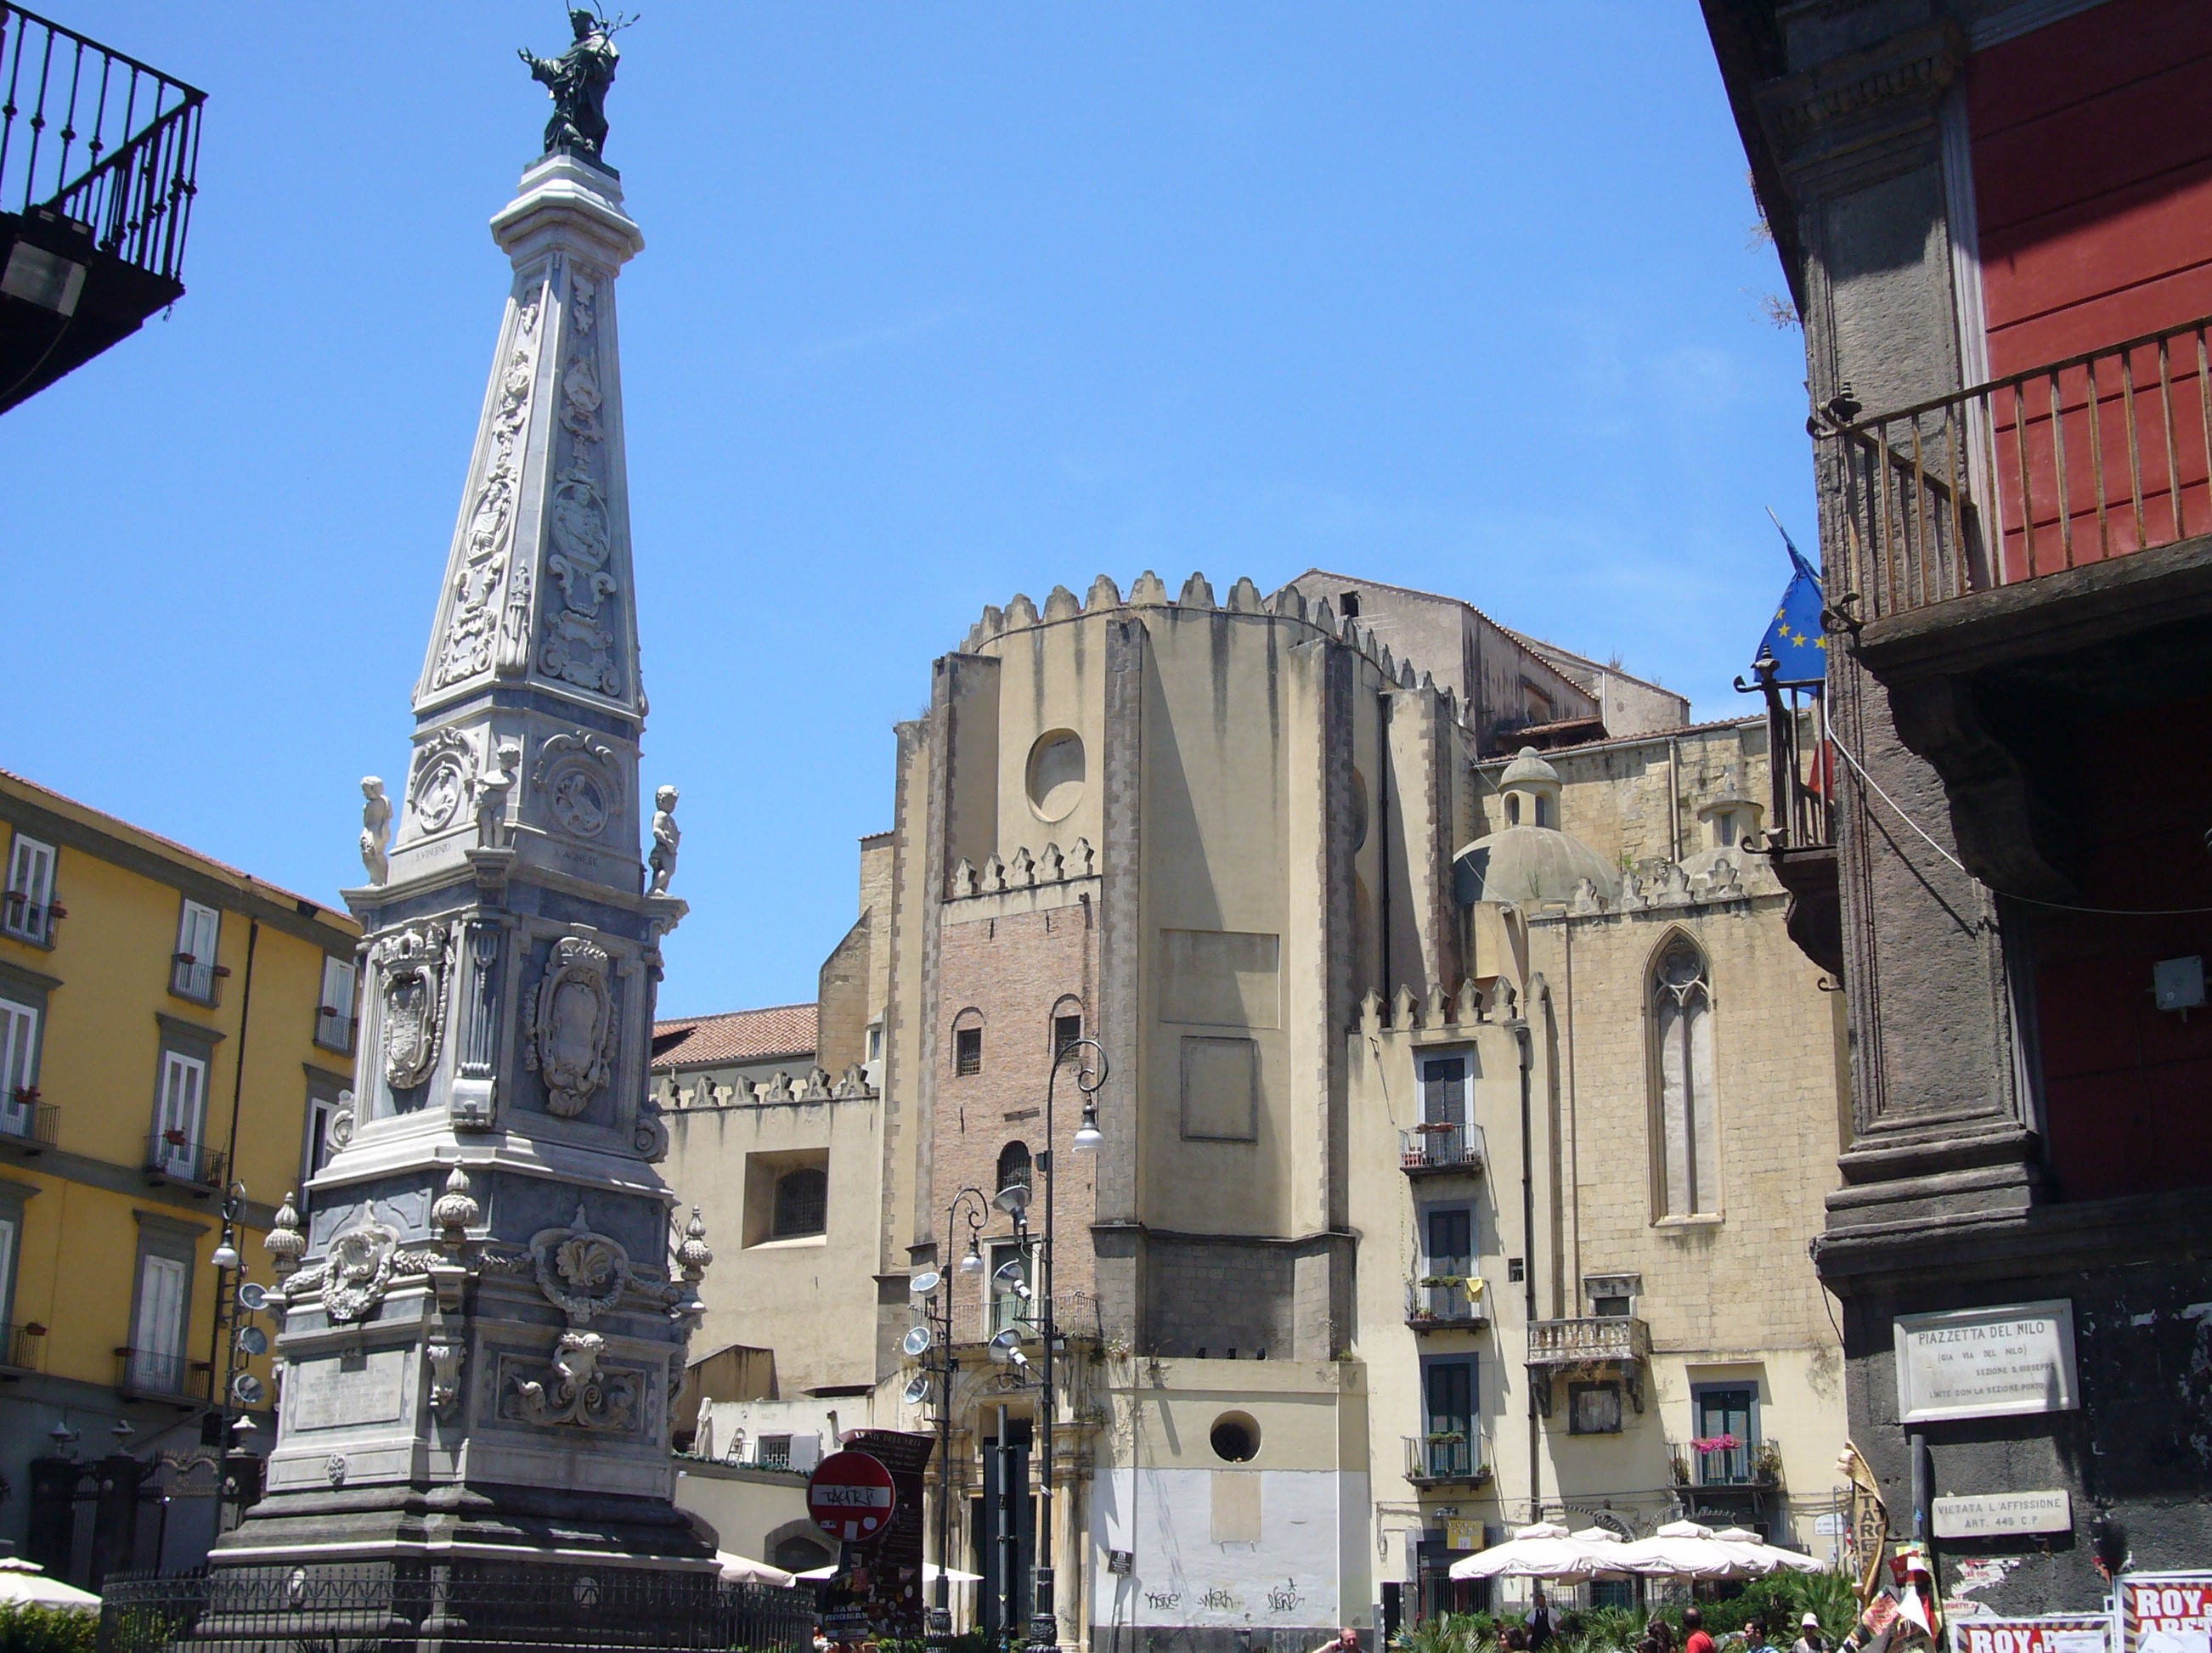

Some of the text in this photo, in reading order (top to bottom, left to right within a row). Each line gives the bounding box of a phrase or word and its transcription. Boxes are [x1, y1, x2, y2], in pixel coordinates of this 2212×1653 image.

[1918, 1322, 2045, 1346] PIAZZETTA DEL NILO
[1962, 1351, 1974, 1360] VIA
[1983, 1349, 1996, 1358] DEL
[2005, 1344, 2028, 1356] NILO)
[1976, 1367, 2008, 1376] SEZIONE
[2019, 1362, 2056, 1373] GIUSEPPE
[1955, 1388, 1973, 1398] CON
[1974, 1387, 1984, 1396] LA
[1987, 1384, 2019, 1394] SEZIONE
[2021, 1382, 2045, 1391] PORTO
[1938, 1503, 1983, 1515] VIETATA
[1965, 1519, 1989, 1529] ART.
[1995, 1517, 2015, 1527] 445
[2136, 1588, 2202, 1617] ROY
[1968, 1629, 2032, 1653] ROY
